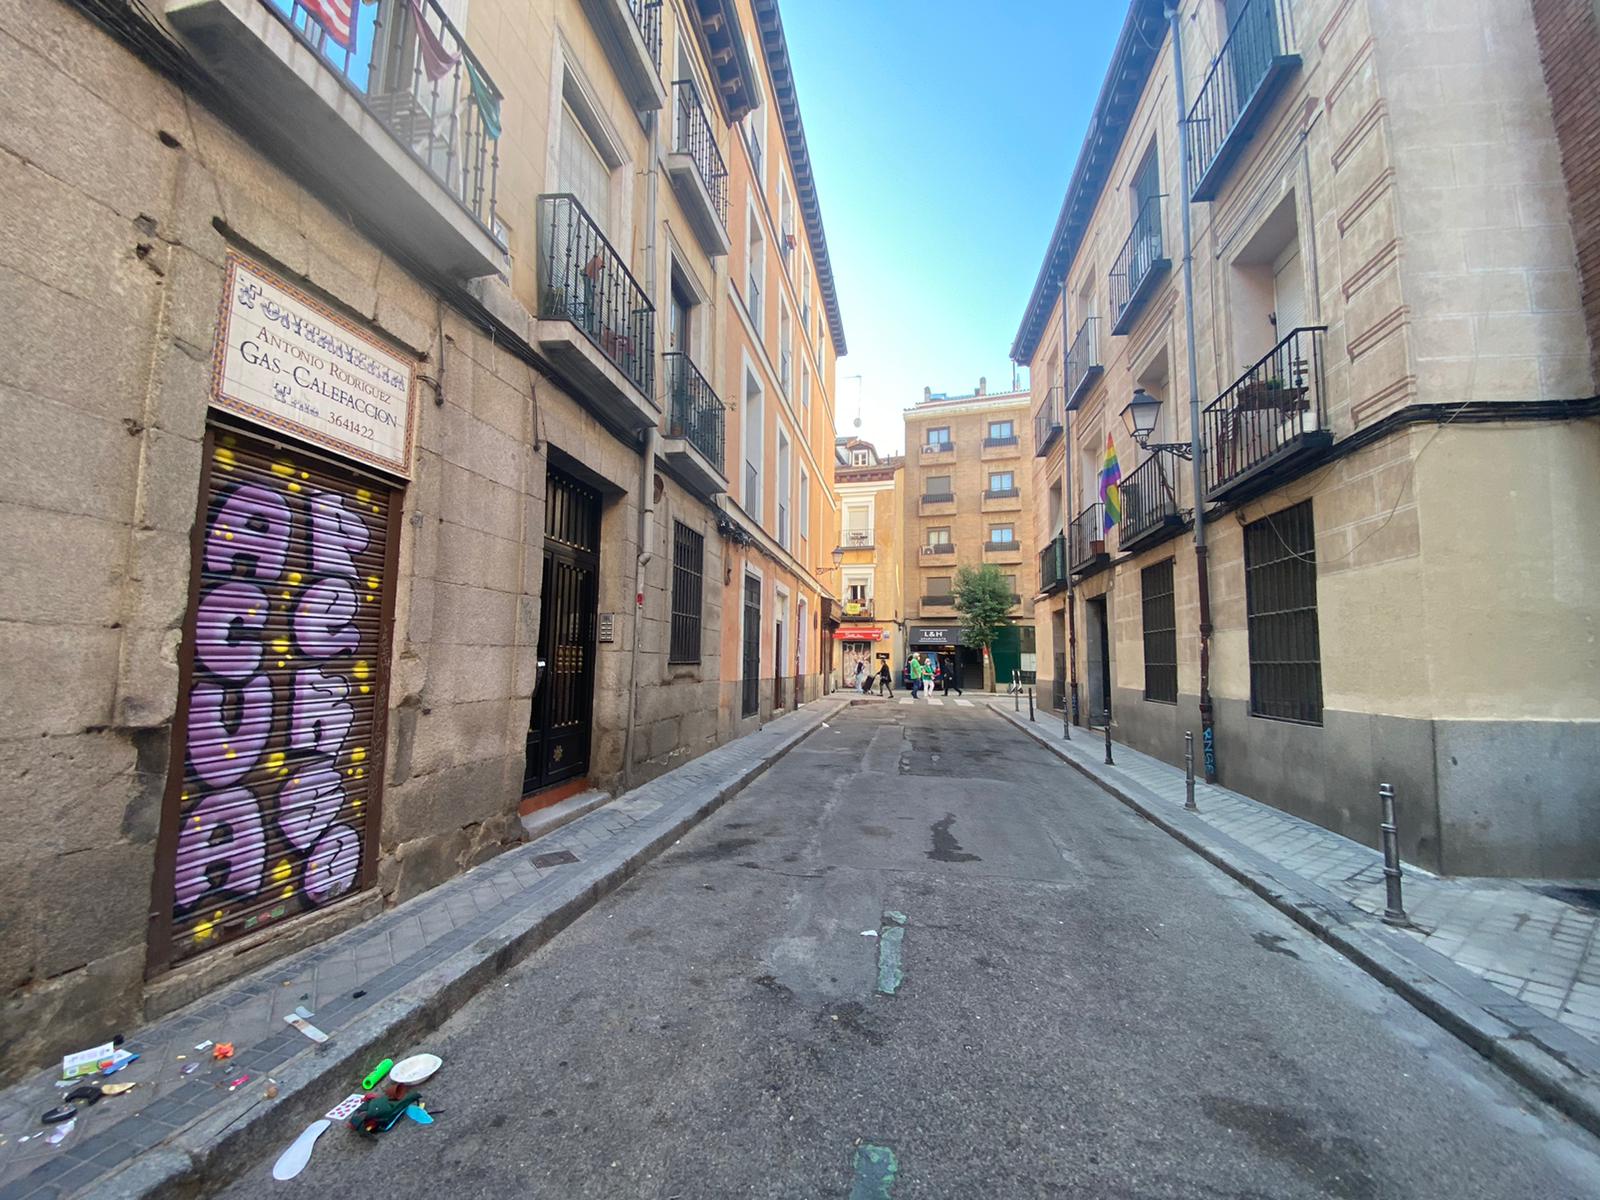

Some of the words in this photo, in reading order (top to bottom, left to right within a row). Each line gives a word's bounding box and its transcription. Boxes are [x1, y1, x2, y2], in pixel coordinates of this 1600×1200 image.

[256, 326, 324, 370] ANTONIO
[329, 362, 391, 404] RODRIGUEZ
[328, 412, 375, 440] 3641422
